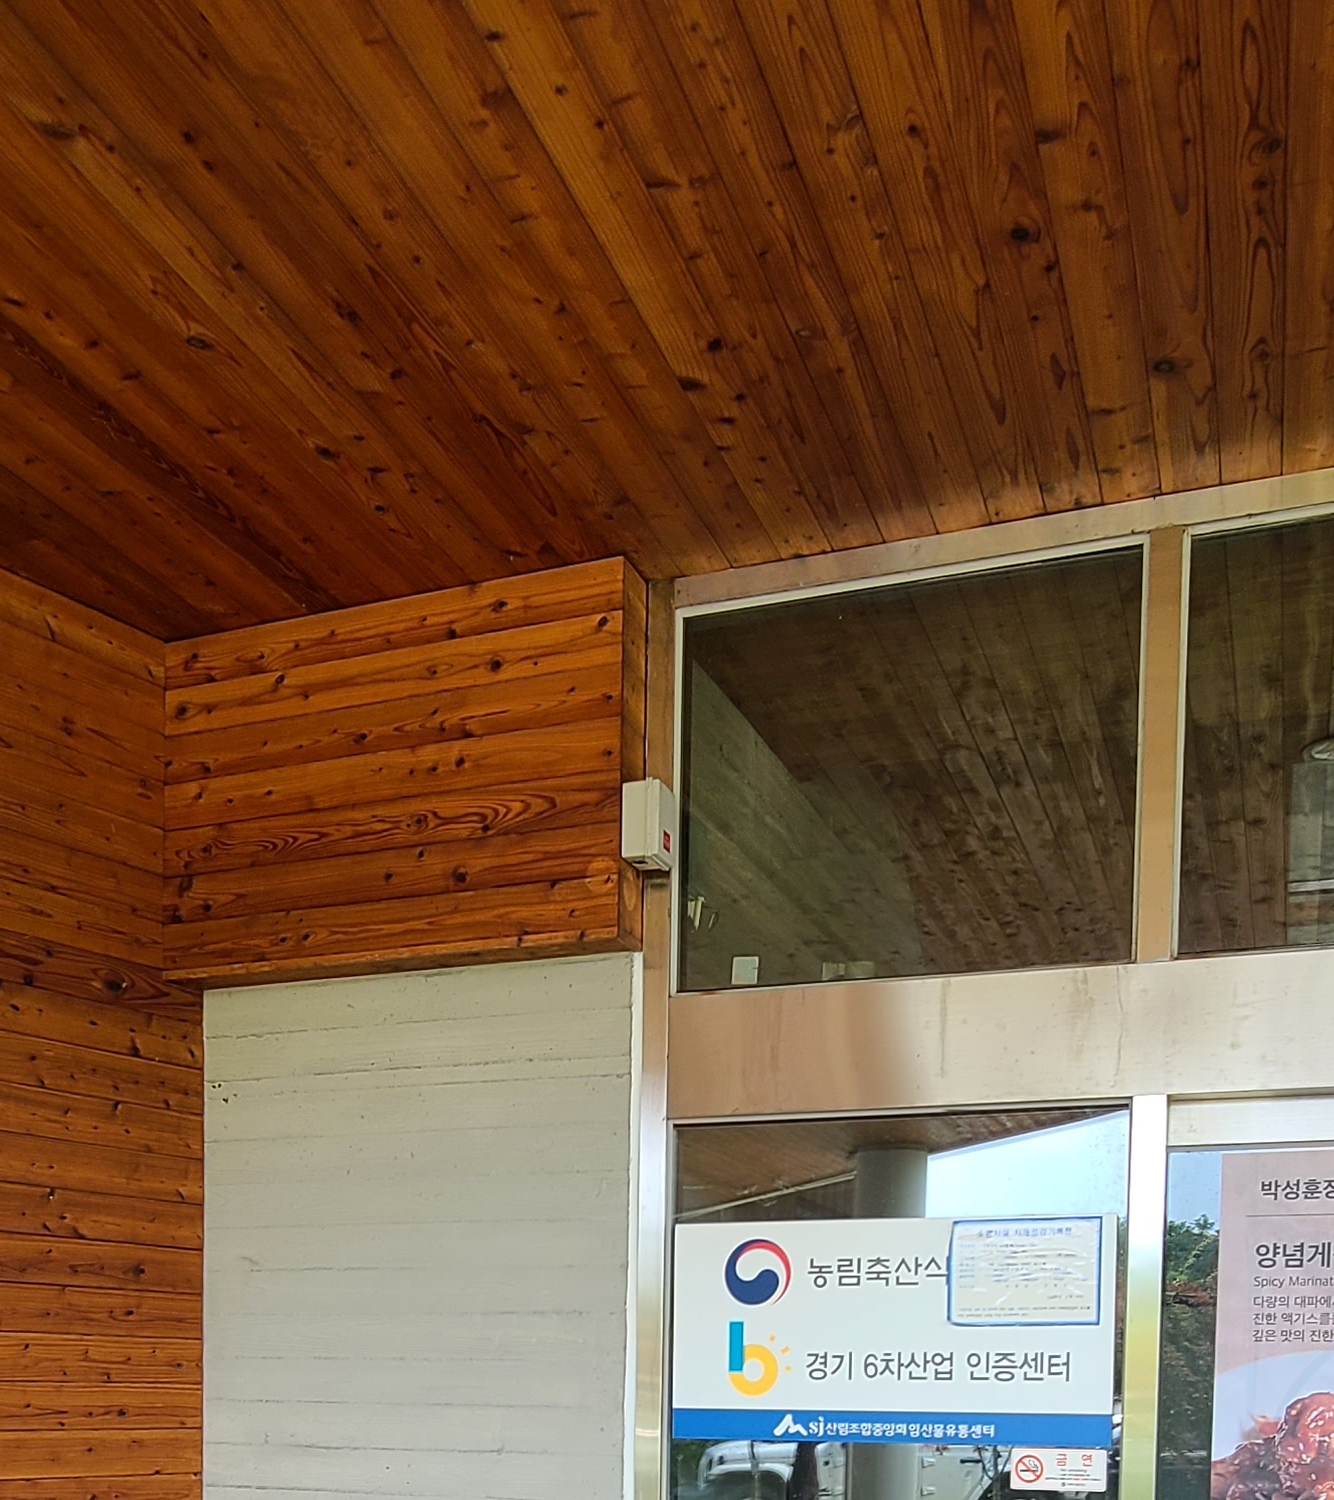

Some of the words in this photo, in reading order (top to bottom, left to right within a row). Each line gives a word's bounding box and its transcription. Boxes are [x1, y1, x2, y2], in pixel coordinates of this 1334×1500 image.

[1253, 1276, 1284, 1288] Spicy
[1253, 1296, 1290, 1308] 다량의
[1252, 1312, 1277, 1325] 진한
[1252, 1329, 1277, 1342] 깊은
[1280, 1329, 1305, 1342] 맛의
[1309, 1329, 1334, 1342] 진한
[806, 1351, 852, 1381] 경기
[863, 1351, 954, 1381] 6차산업
[967, 1351, 1070, 1382] 인증센터
